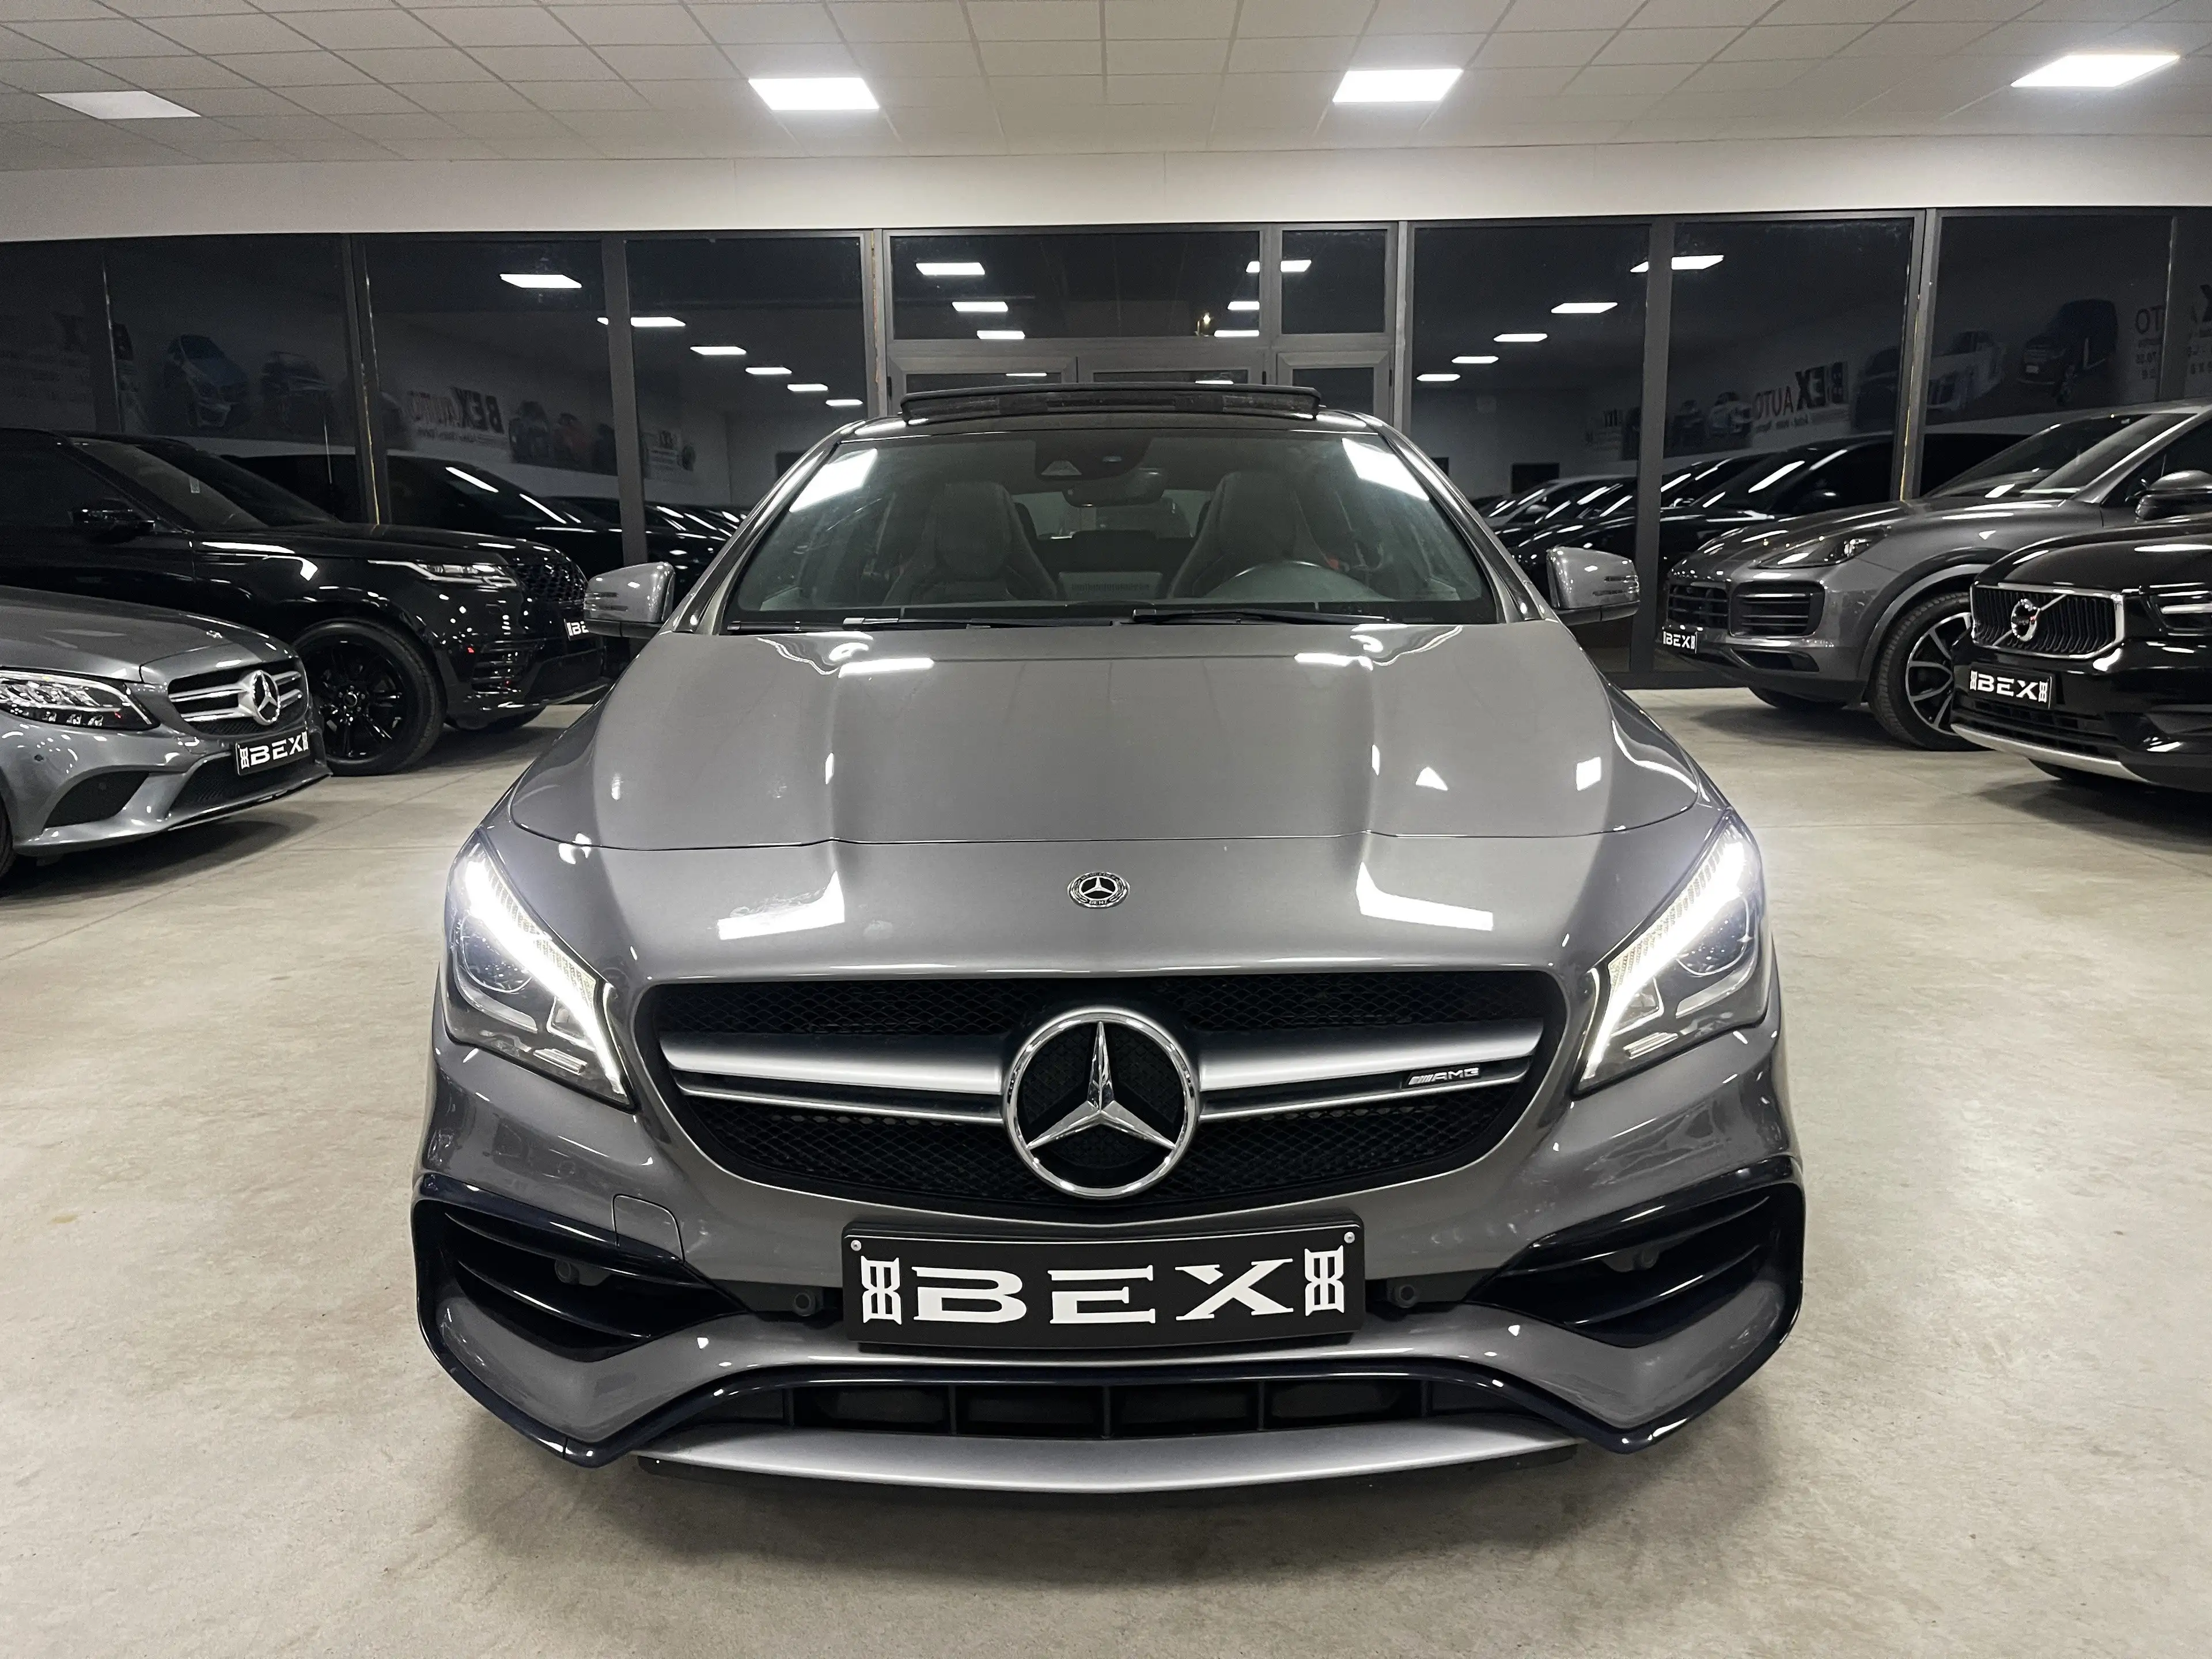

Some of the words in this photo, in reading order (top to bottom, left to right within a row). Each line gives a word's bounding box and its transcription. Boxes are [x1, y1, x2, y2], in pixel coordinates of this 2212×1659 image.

[571, 621, 589, 635] BE
[1666, 632, 1691, 649] BEX
[1977, 673, 2039, 700] BEX
[249, 734, 303, 766] BEX
[1431, 1067, 1479, 1082] AMG
[911, 1259, 1294, 1324] BEX
